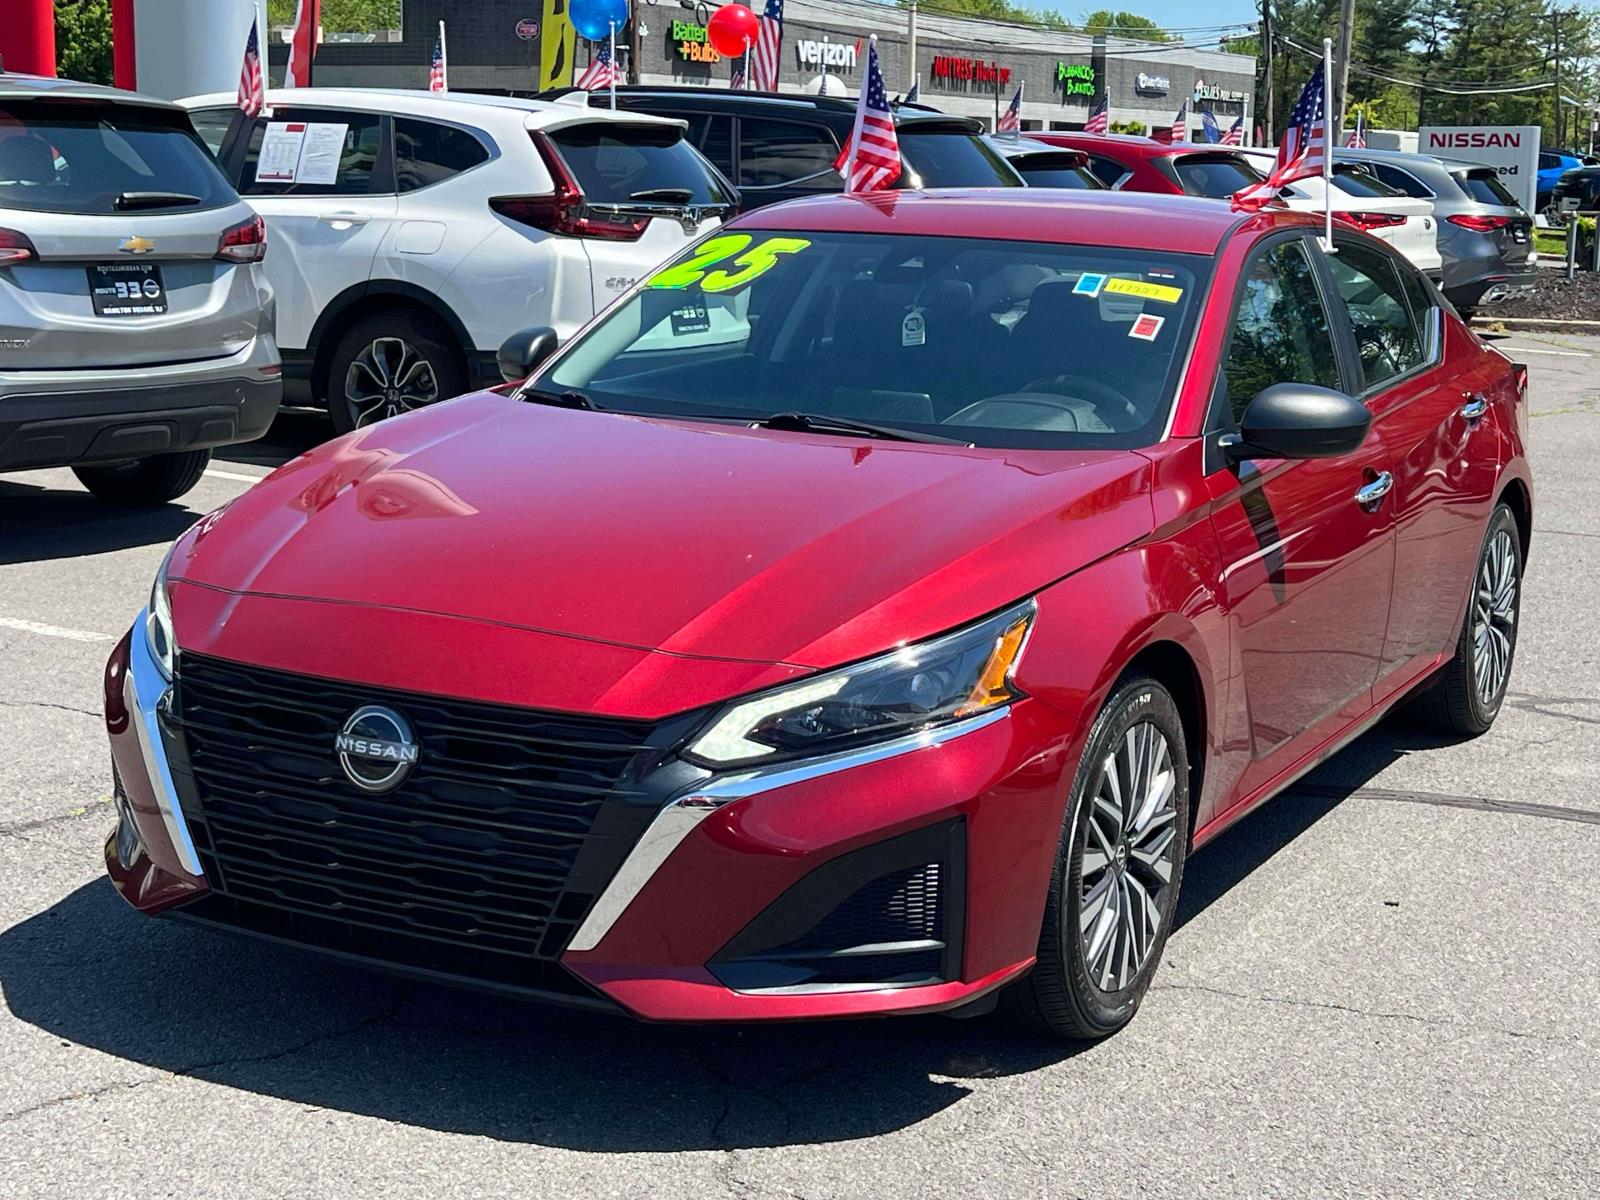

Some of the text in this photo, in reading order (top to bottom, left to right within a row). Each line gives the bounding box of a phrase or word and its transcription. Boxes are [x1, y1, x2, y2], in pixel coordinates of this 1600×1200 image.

[797, 35, 857, 67] verizon
[1430, 133, 1521, 148] NISSAN
[646, 234, 812, 293] 25
[115, 281, 143, 299] 33
[336, 735, 416, 761] NISSAN
